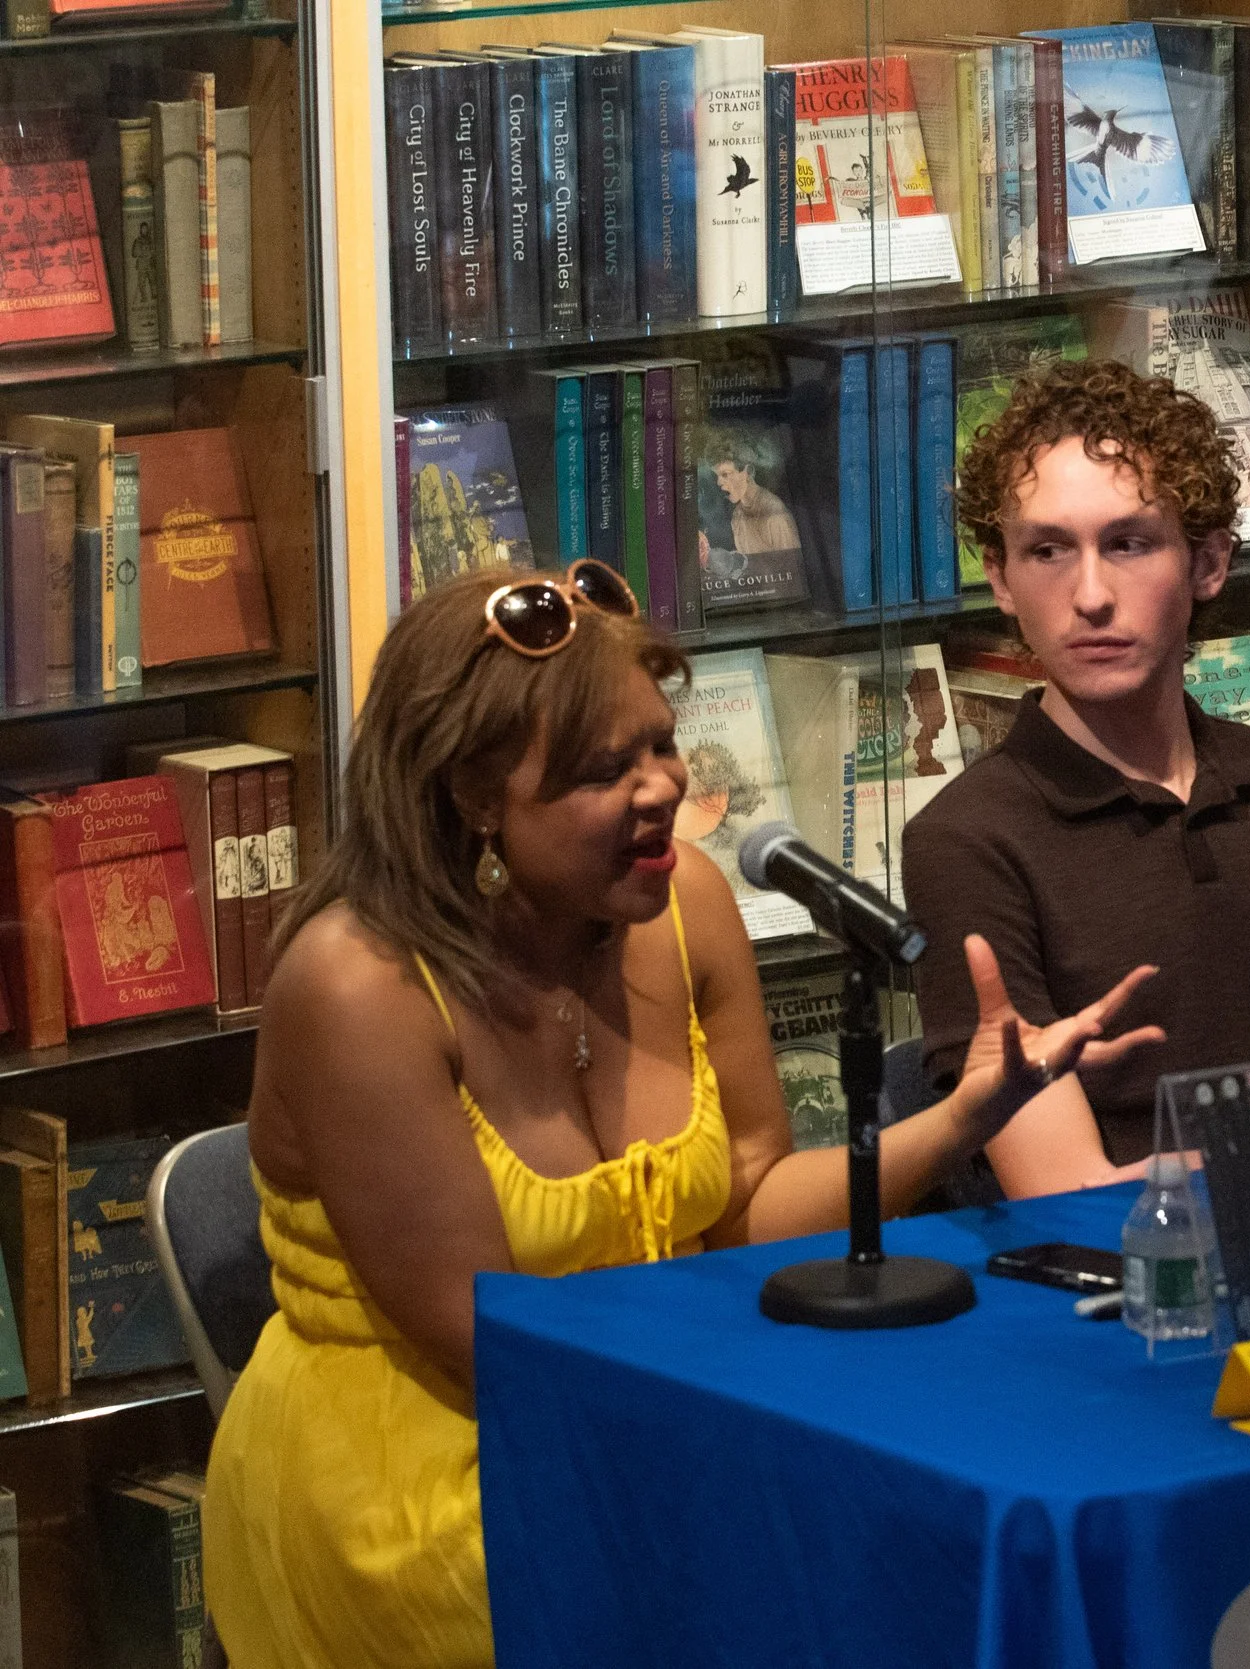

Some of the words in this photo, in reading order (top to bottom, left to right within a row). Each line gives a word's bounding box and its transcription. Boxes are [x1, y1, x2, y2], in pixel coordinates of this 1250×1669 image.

[799, 60, 884, 87] HENRY
[979, 69, 988, 82] THE
[708, 89, 761, 102] JONATHAN
[980, 83, 989, 106] PRINCE
[1019, 85, 1028, 95] OF
[553, 97, 569, 128] The
[599, 86, 619, 141] Lord
[658, 80, 671, 127] Queen
[708, 101, 761, 113] STRANGE
[1019, 97, 1028, 112] THE
[406, 104, 426, 146] City
[456, 102, 475, 142] City
[731, 120, 745, 131] &
[808, 127, 858, 141] BEVERLY
[981, 115, 991, 144] WAITING
[1004, 122, 1014, 147] LANDS
[1019, 113, 1029, 143] SPIRITS
[508, 93, 527, 197] Clockwork
[660, 129, 673, 147] of
[708, 138, 720, 147] Mr
[722, 136, 761, 146] NORRELL
[778, 132, 787, 142] A
[1049, 104, 1062, 176] CATCHING
[410, 150, 425, 168] of
[459, 146, 475, 163] of
[554, 132, 570, 181] Bane
[602, 146, 621, 171] of
[660, 149, 673, 172] Air
[778, 141, 789, 168] GIRL
[779, 168, 789, 197] FROM
[797, 165, 814, 177] BUS
[799, 176, 816, 188] STOP
[411, 170, 428, 213] Lost
[660, 173, 674, 201] and
[1053, 182, 1063, 216] FIRE
[460, 167, 479, 256] Heavenly
[712, 217, 739, 226] Susanna
[779, 196, 790, 248] YAMHILL
[511, 202, 529, 262] Prince
[555, 186, 573, 290] Chronicles
[602, 175, 621, 277] Shadows
[661, 203, 675, 270] Darkness
[413, 218, 431, 273] Souls
[465, 262, 481, 298] Fire
[1183, 323, 1227, 342] SUGAR
[1201, 313, 1234, 330] STORY
[1152, 318, 1168, 357] The
[708, 392, 763, 409] Hatcher
[416, 436, 438, 447] Susan
[437, 433, 462, 446] Cooper
[599, 431, 610, 453] The
[656, 426, 667, 458] Silver
[115, 476, 134, 486] BOY
[600, 454, 611, 483] Dark
[602, 484, 610, 494] is
[657, 475, 667, 491] the
[682, 474, 693, 501] King
[116, 504, 136, 517] 1812
[599, 495, 612, 531] Rising
[105, 515, 114, 559] FIERCE
[159, 539, 192, 557] CENTRE
[203, 536, 233, 554] EARTH
[105, 561, 114, 594] FACE
[737, 571, 794, 588] COVILLE
[694, 686, 726, 702] AND
[706, 697, 753, 716] PEACH
[700, 720, 730, 735] DAHL
[843, 751, 856, 786] THE
[53, 797, 84, 818] The
[83, 784, 169, 812] Wonderful
[842, 789, 857, 872] WITCHES
[133, 981, 179, 1001] Nesbit
